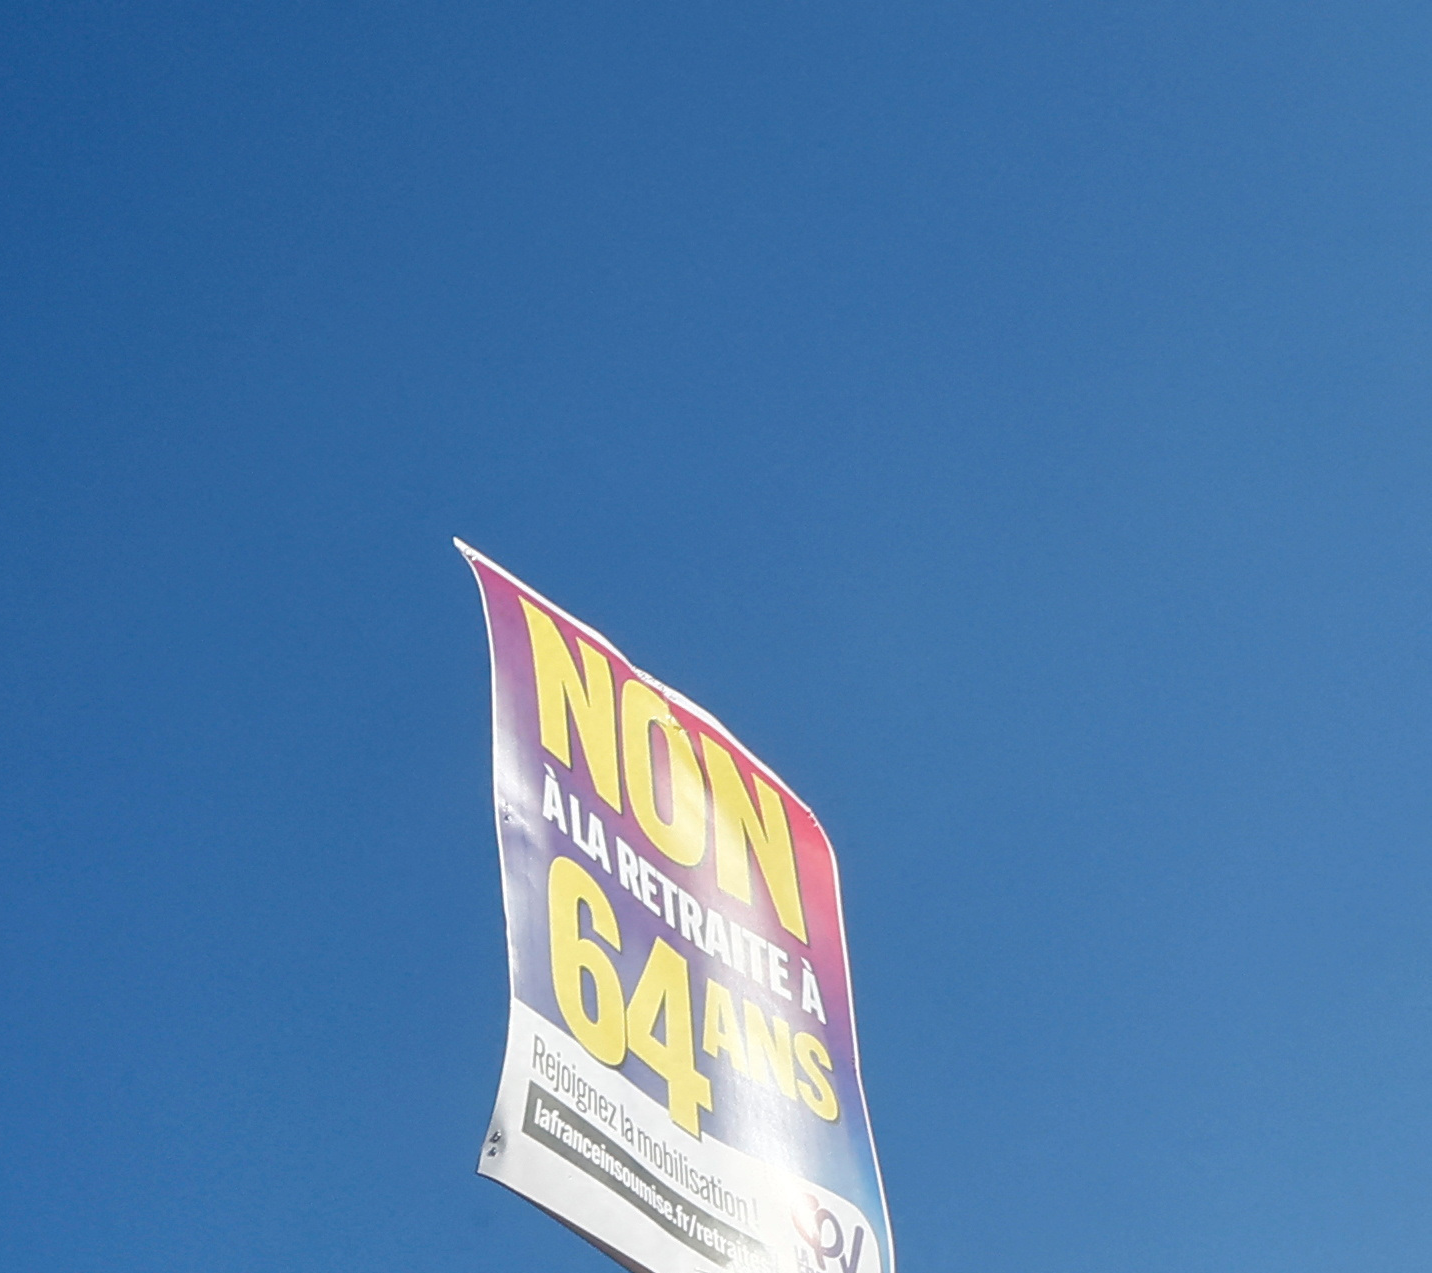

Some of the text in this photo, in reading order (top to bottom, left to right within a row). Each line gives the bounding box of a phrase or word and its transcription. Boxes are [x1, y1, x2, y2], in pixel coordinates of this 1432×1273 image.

[519, 597, 808, 944] NON
[543, 763, 826, 1025] À LA RETRAITE À
[548, 856, 838, 1139] 64 ANS
